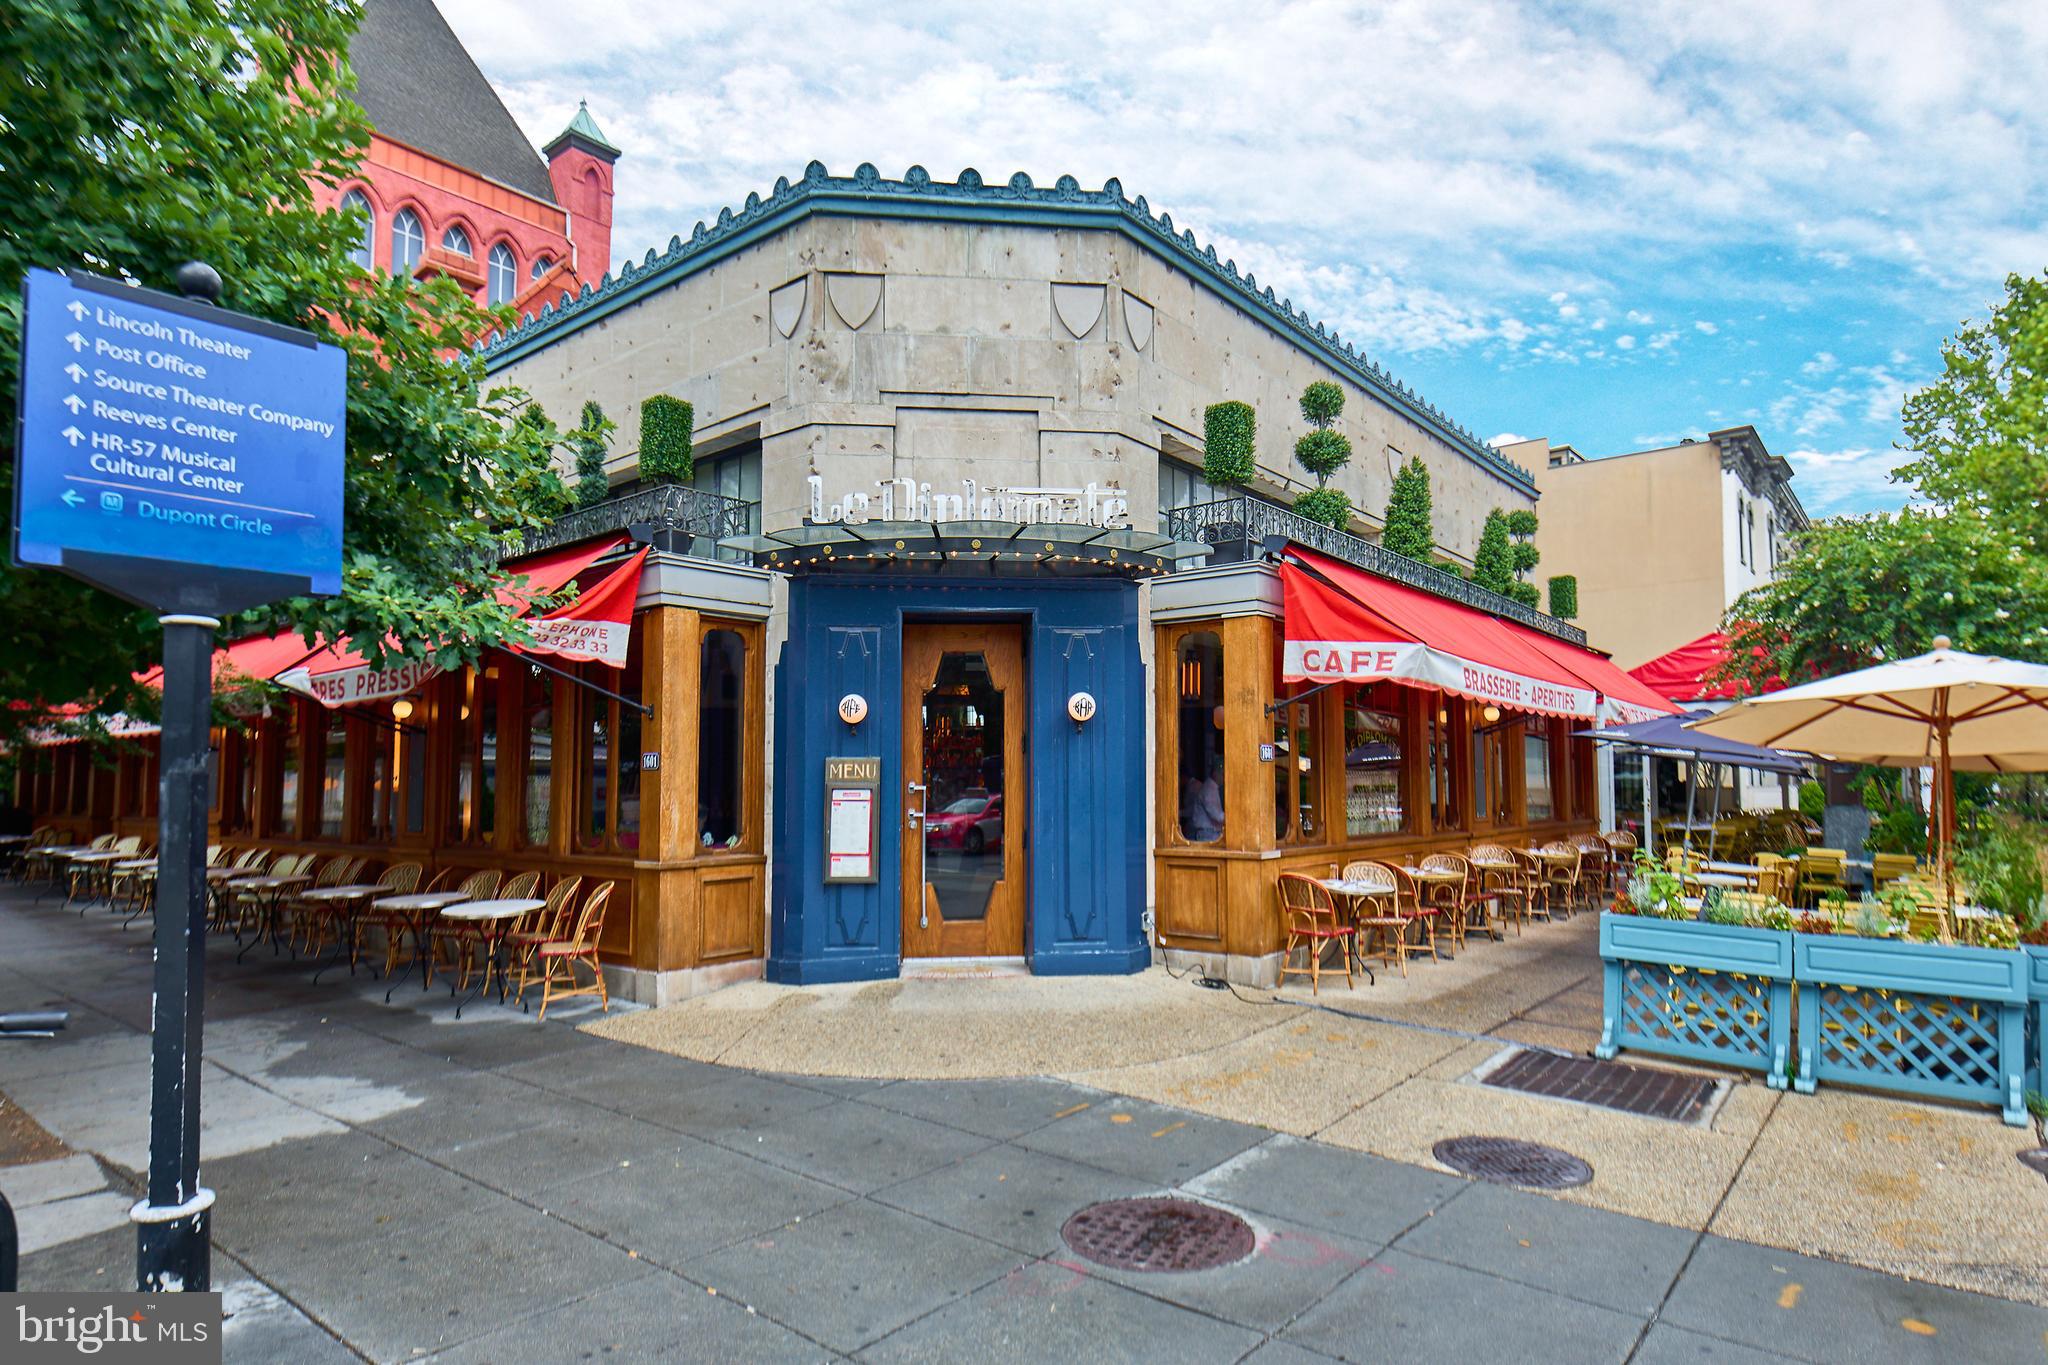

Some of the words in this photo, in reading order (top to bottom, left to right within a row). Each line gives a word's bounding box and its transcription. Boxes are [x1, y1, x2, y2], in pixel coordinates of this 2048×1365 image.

[96, 306, 173, 342] Lincoln
[177, 326, 252, 361] Theater
[95, 338, 141, 367] Post
[146, 351, 207, 379] Office
[92, 400, 167, 431] Reeves
[171, 415, 238, 444] Center
[94, 369, 167, 401] Source
[171, 384, 246, 417] Theater
[248, 404, 335, 439] Company
[91, 431, 156, 457] HR-57
[161, 444, 236, 473] Musical
[90, 454, 174, 483] Cultural
[178, 468, 245, 494] Center
[138, 500, 216, 527] Dupont
[220, 513, 273, 536] Circle
[807, 475, 869, 526] Le
[874, 477, 1129, 530] Diplomate
[1302, 648, 1399, 674] CAFE
[1463, 667, 1521, 701] BRASSERIE
[1531, 685, 1575, 711] APERITIFS
[829, 763, 877, 779] MENU
